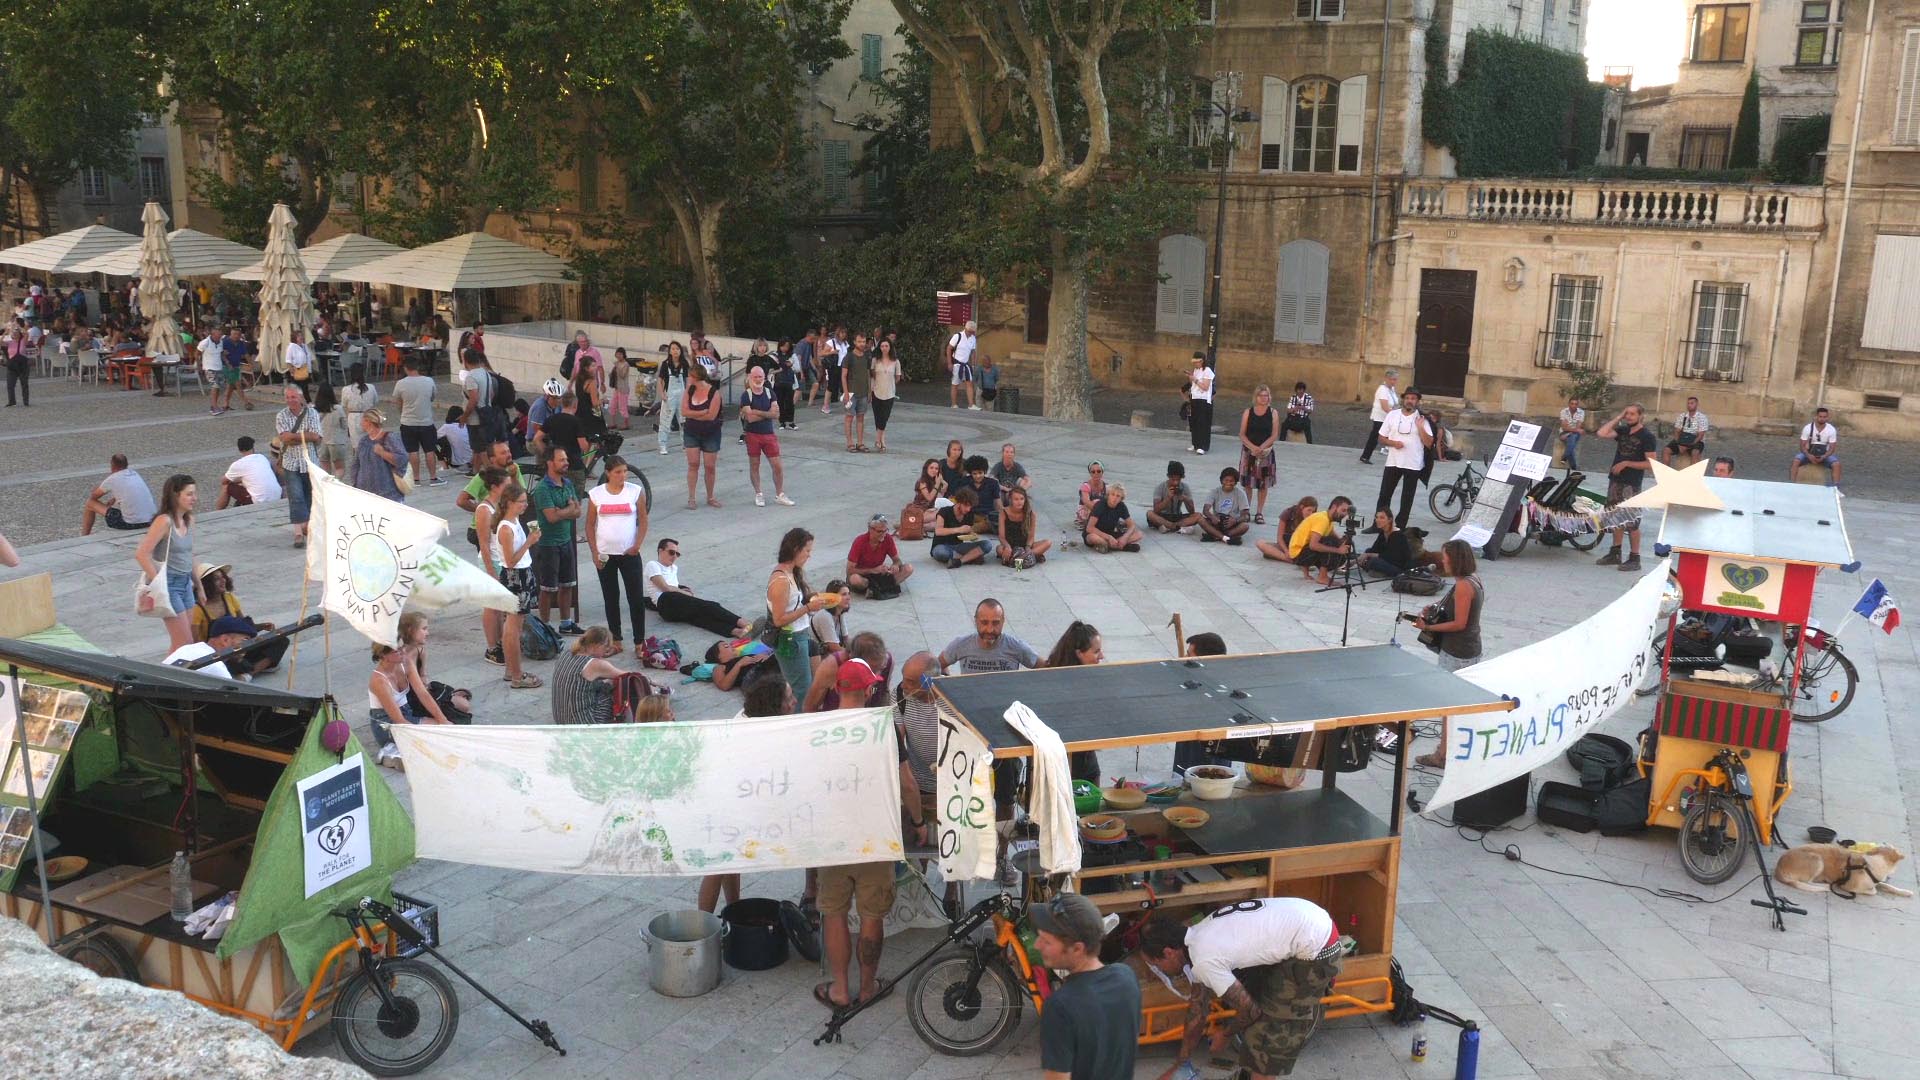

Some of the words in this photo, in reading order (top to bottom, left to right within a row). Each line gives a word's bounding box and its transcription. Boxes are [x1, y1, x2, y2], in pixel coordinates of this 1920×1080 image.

[335, 525, 351, 561] FOR
[350, 513, 391, 535] THE
[372, 544, 418, 622] PLANET
[321, 791, 341, 803] PLANET
[341, 781, 361, 793] EARTH
[325, 789, 356, 808] MOVEMENT
[318, 867, 330, 878] THE
[331, 856, 356, 872] PLANET
[323, 858, 338, 869] WALK
[339, 852, 350, 862] FOR
